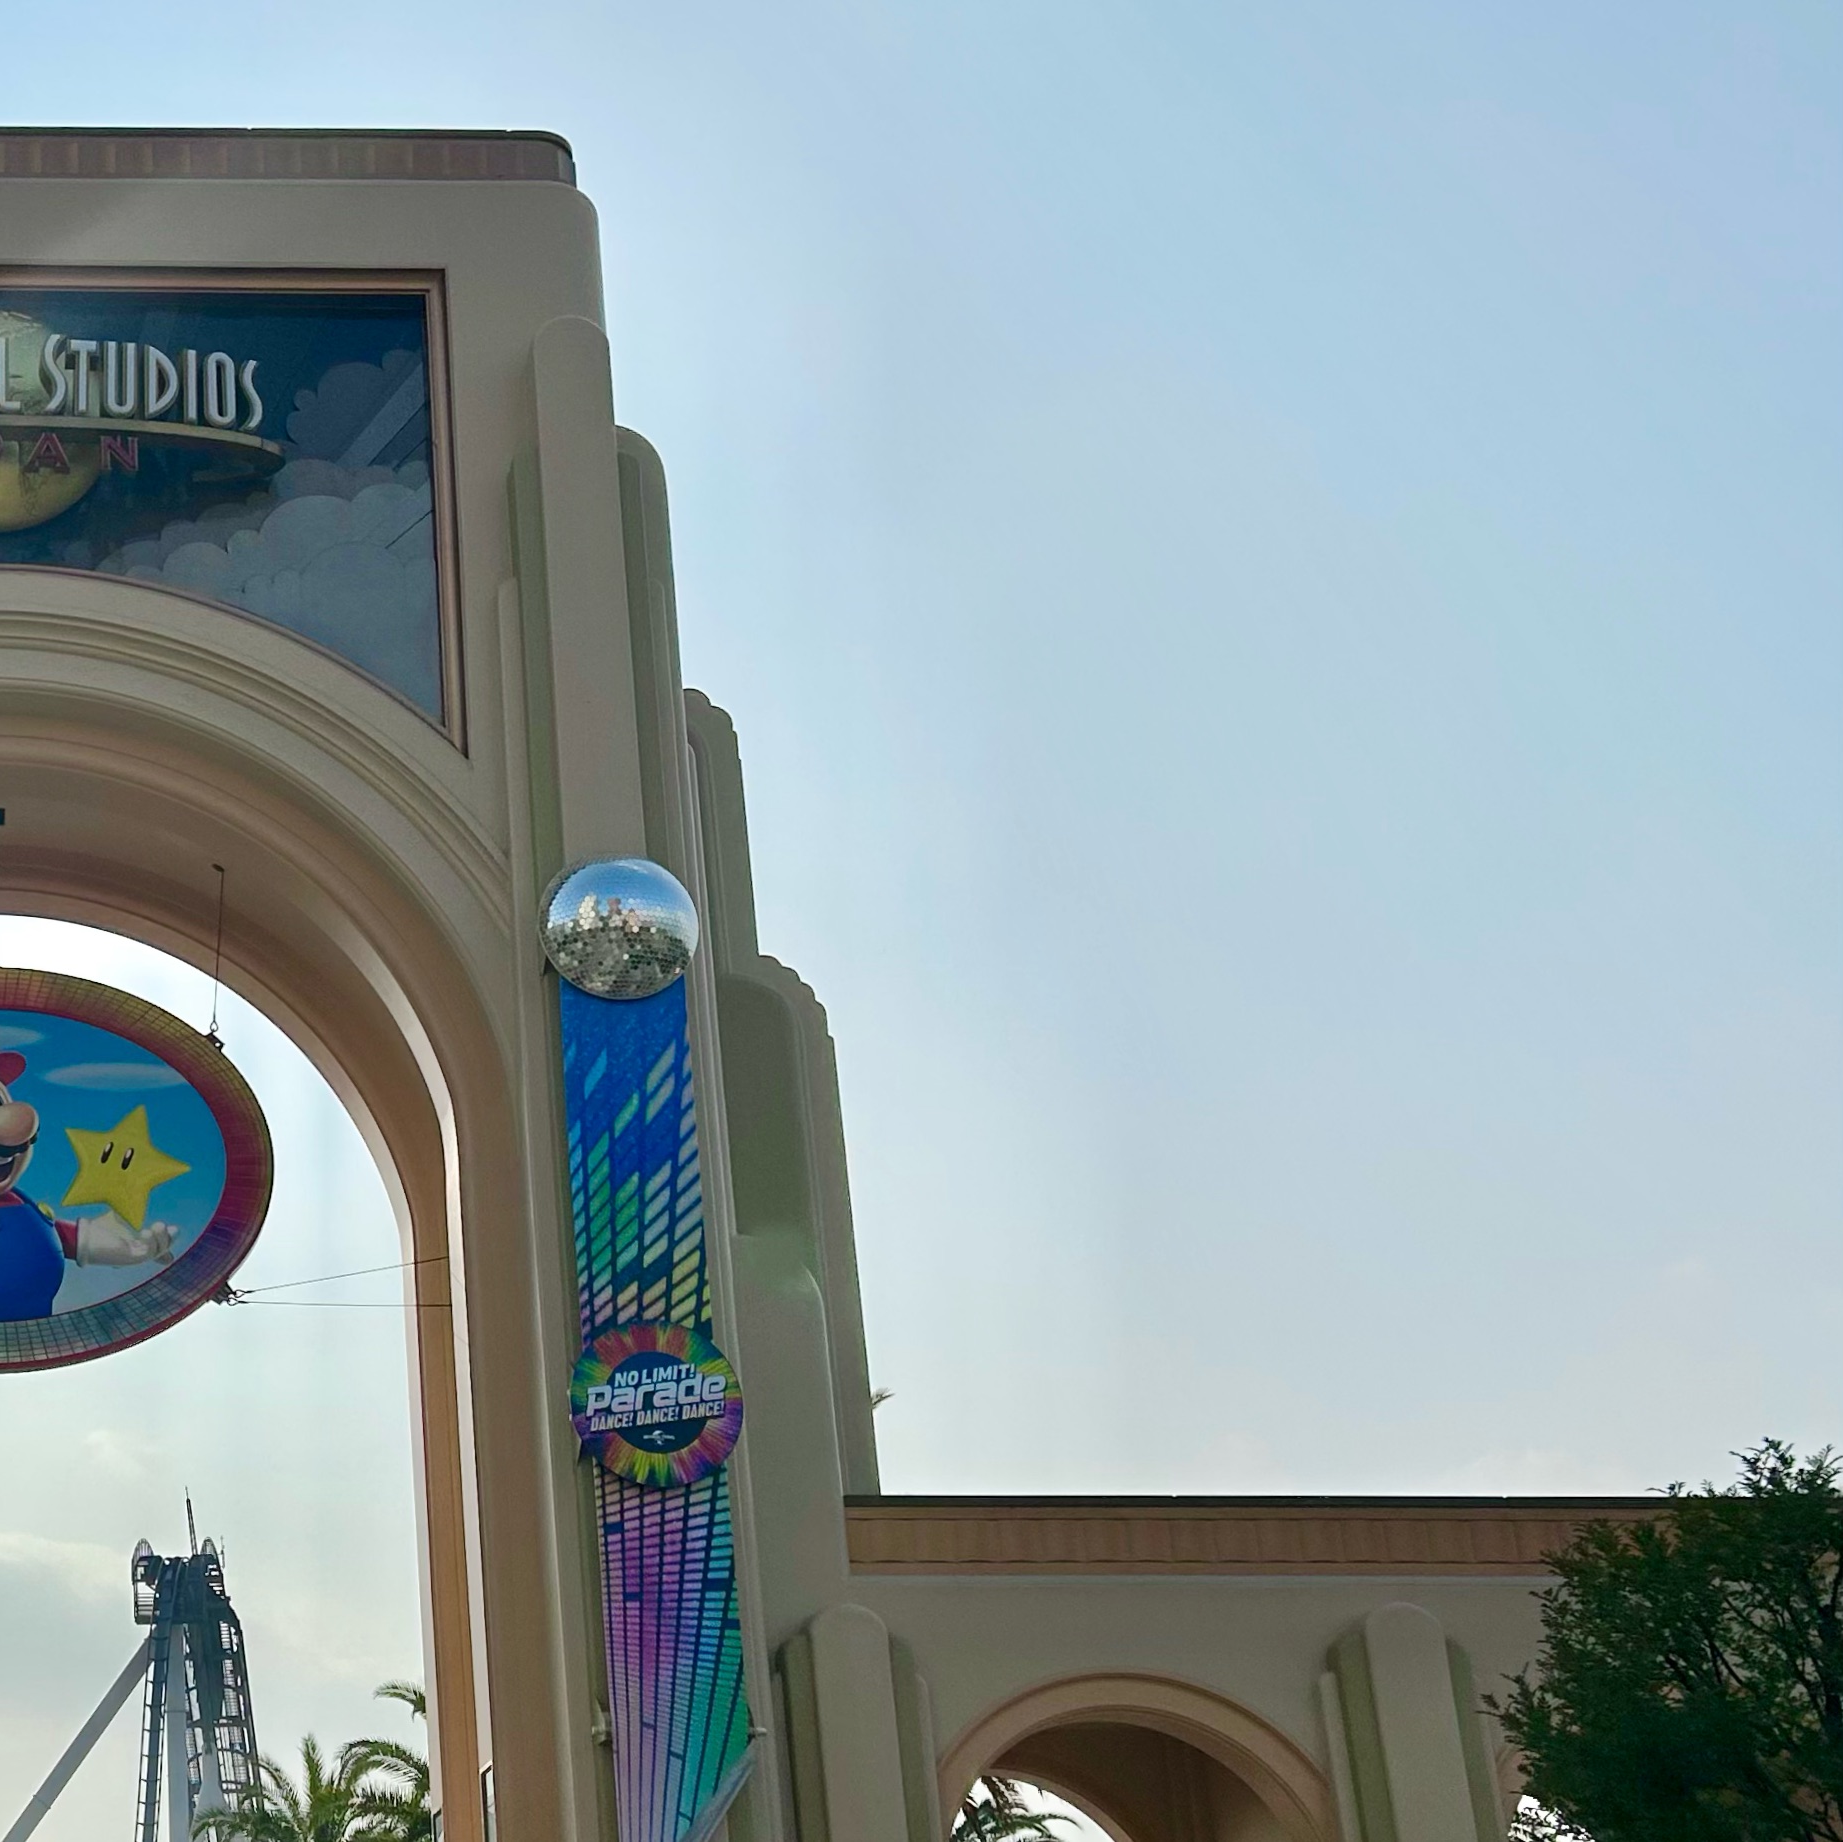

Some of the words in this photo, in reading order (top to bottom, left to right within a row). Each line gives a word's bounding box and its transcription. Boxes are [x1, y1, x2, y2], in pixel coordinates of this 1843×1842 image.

[42, 334, 264, 431] STUDIOS
[615, 1371, 638, 1387] NO
[641, 1364, 696, 1384] LIMIT!
[586, 1373, 726, 1416] Parade
[591, 1414, 633, 1431] DANCE!
[637, 1408, 679, 1425] DANCE!
[682, 1401, 724, 1419] DANCE!
